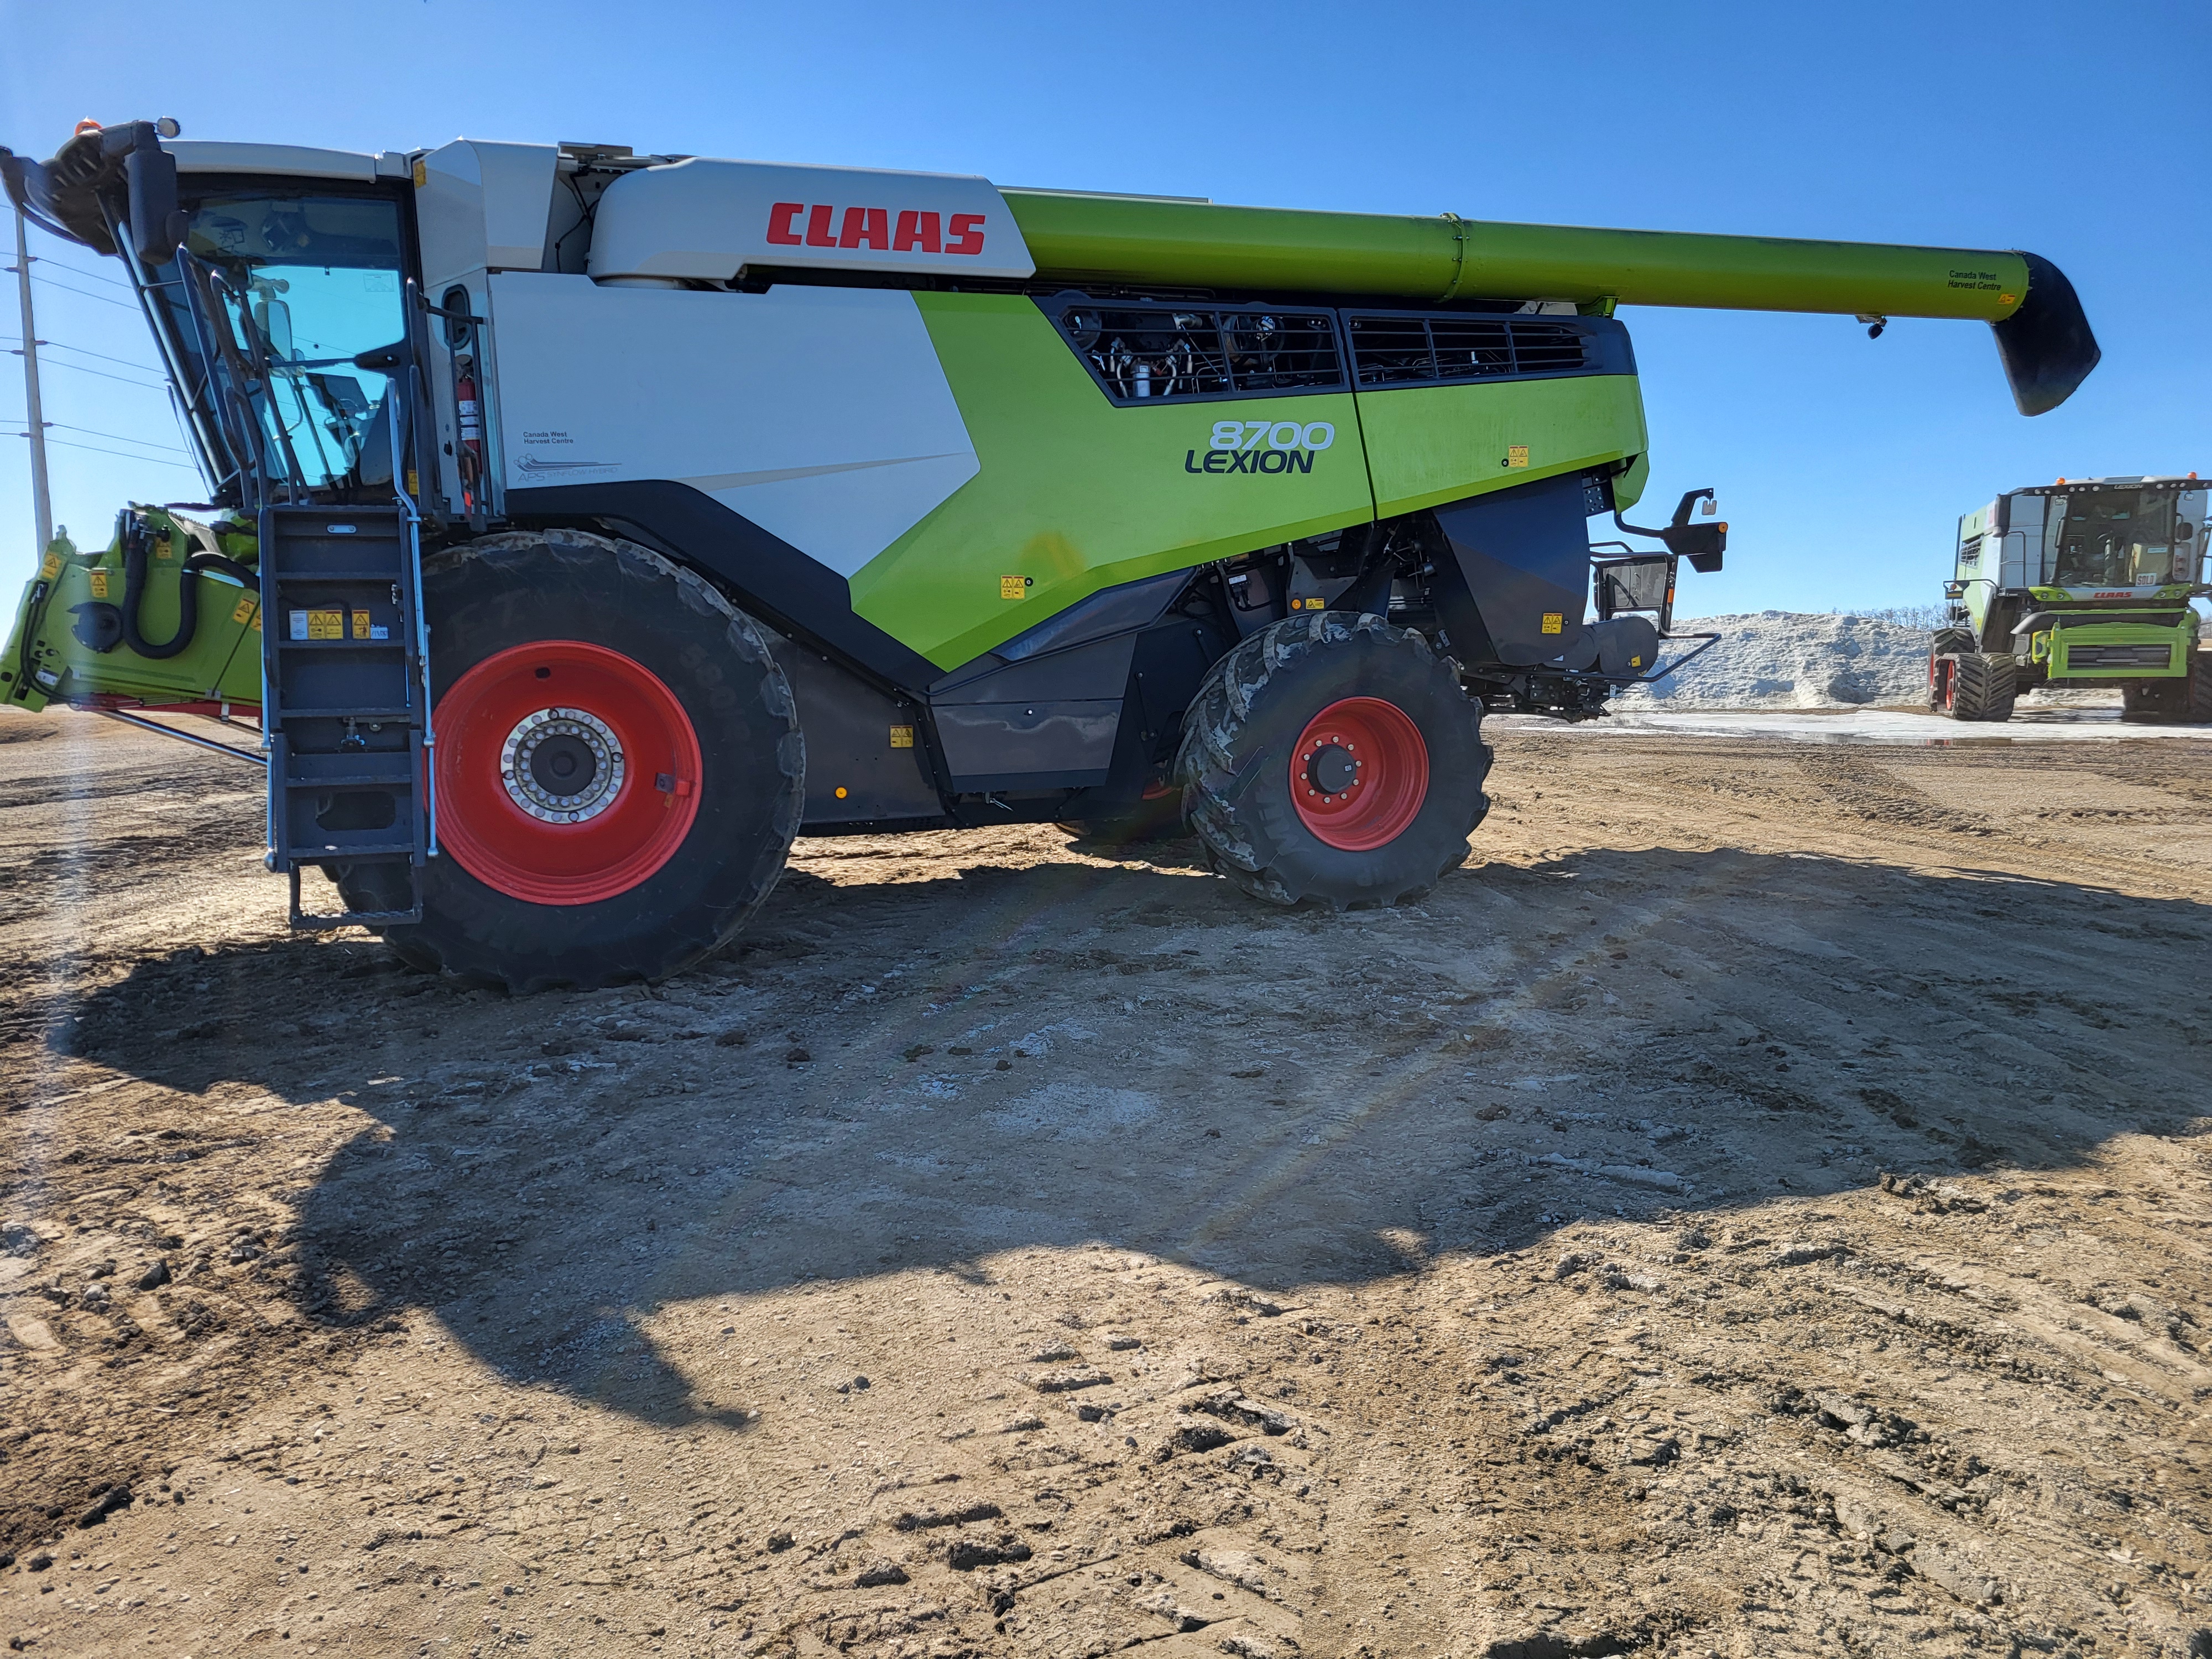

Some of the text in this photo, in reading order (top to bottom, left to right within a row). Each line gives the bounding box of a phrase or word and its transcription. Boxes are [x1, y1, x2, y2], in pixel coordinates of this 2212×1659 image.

[766, 202, 986, 255] CLAAS
[1949, 270, 1996, 280] Canada West
[1948, 280, 2001, 290] Harvest Centre
[1209, 421, 1335, 451] 8700
[1185, 450, 1315, 474] LEXION
[518, 472, 545, 482] APS
[547, 469, 586, 477] SYNFLOW
[2137, 575, 2154, 585] SOLD
